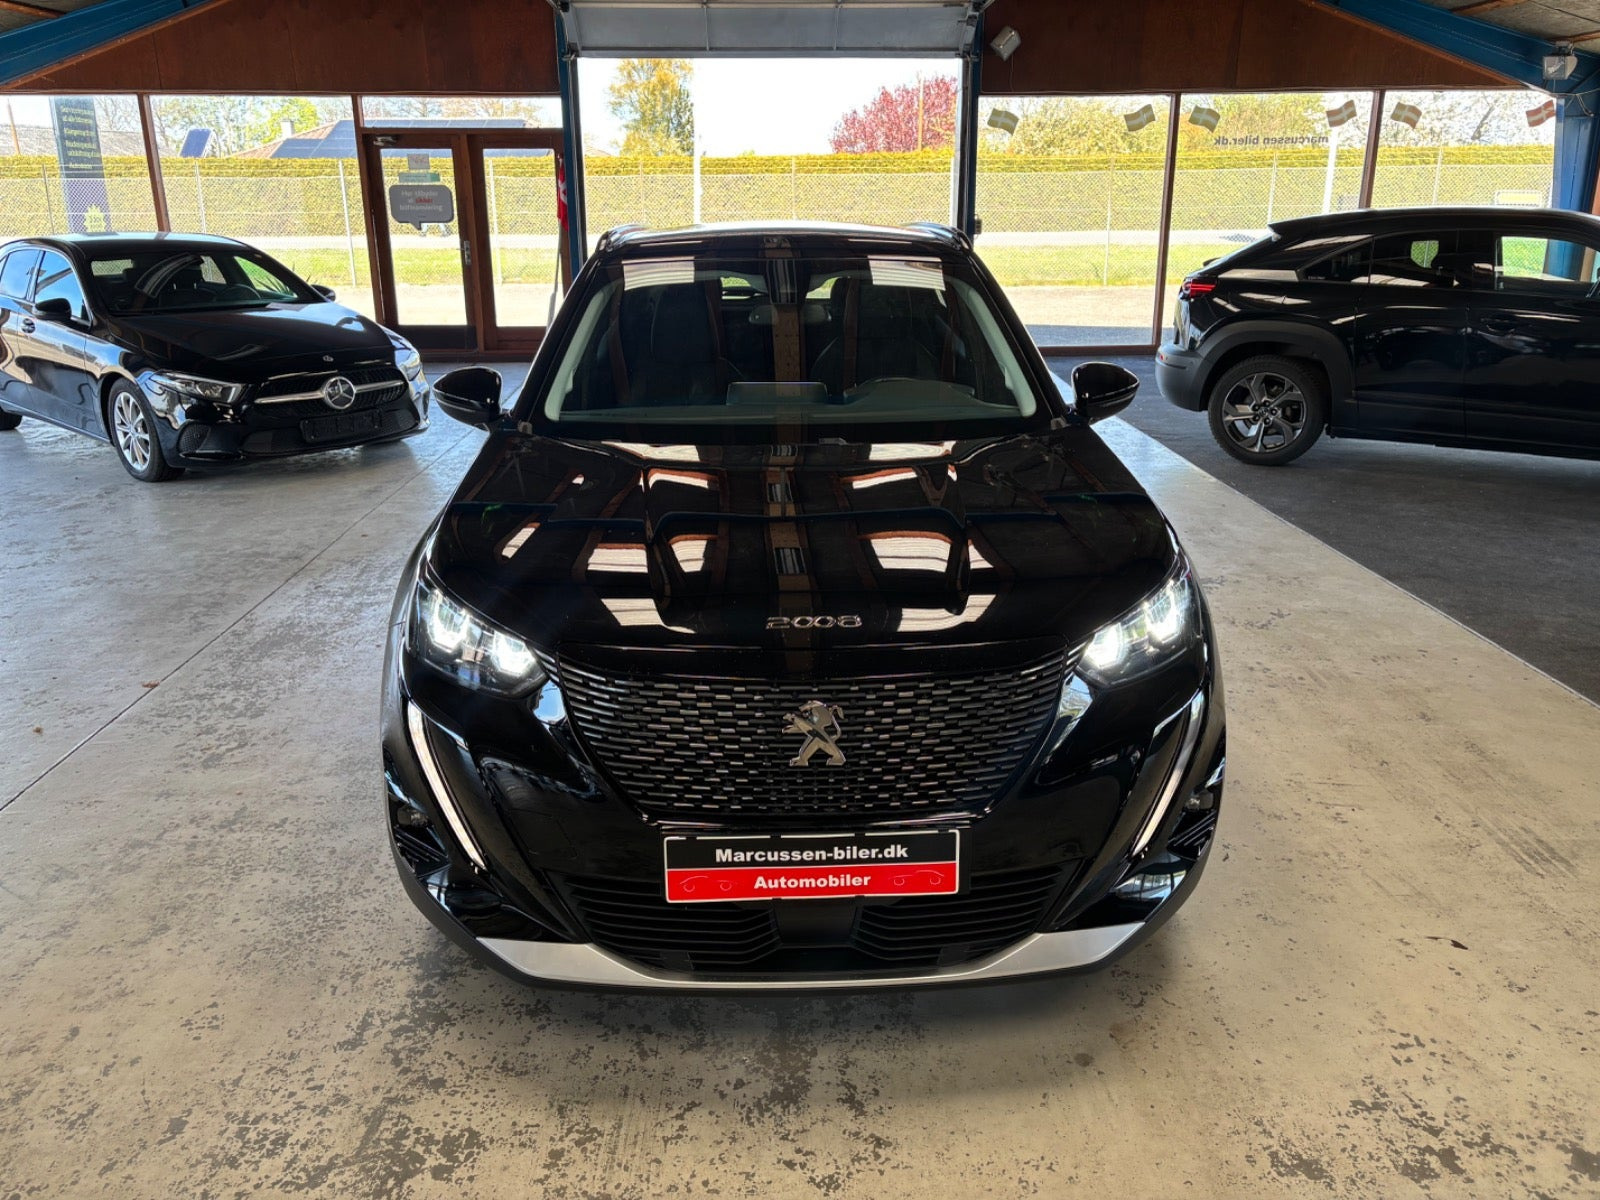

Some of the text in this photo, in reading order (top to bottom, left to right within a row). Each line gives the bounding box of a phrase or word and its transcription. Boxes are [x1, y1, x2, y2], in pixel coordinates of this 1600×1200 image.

[766, 615, 862, 629] 2008
[715, 844, 909, 863] Marcussen-biler.dk
[754, 873, 871, 889] Automobiler
